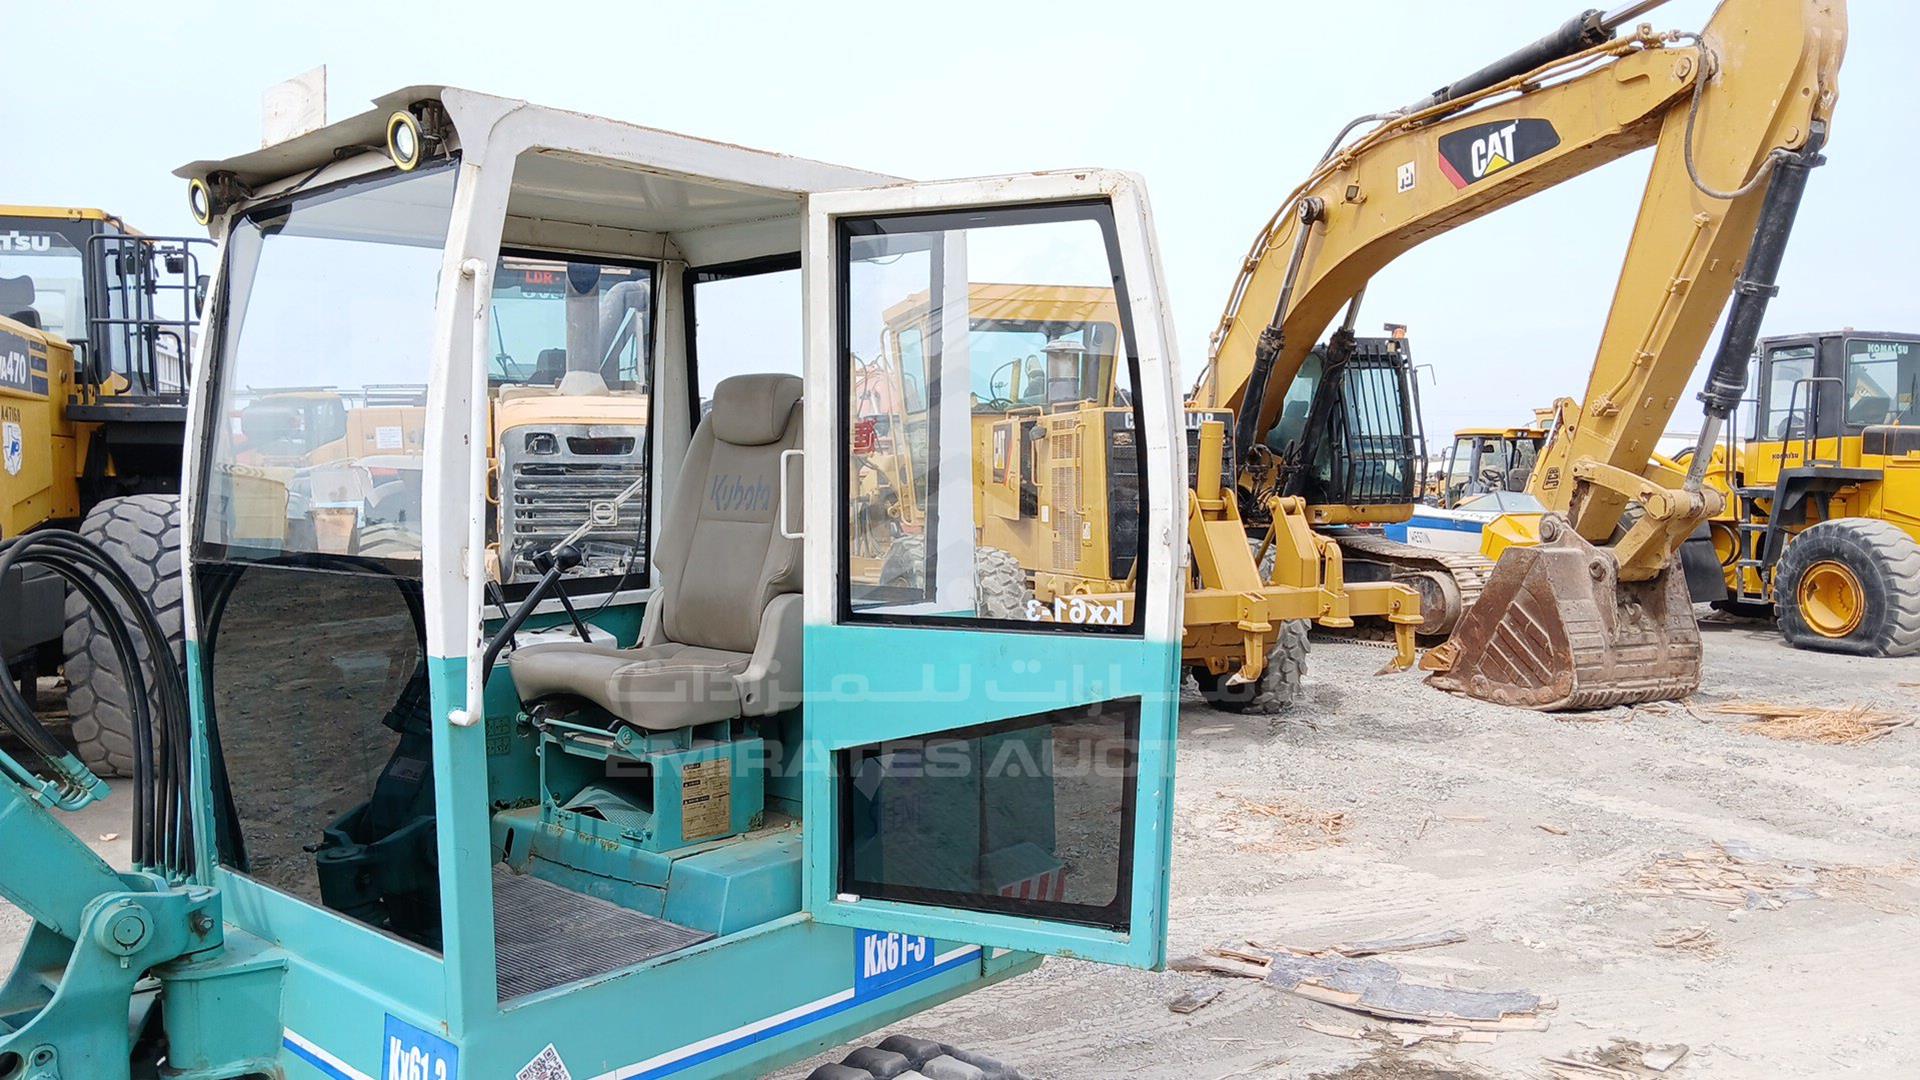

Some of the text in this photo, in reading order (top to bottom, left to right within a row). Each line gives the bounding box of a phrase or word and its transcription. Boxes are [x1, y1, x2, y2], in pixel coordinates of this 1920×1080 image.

[1471, 124, 1516, 178] CAT
[0, 230, 50, 251] TSU
[1867, 343, 1909, 355] KOMATSU
[0, 350, 26, 384] A470
